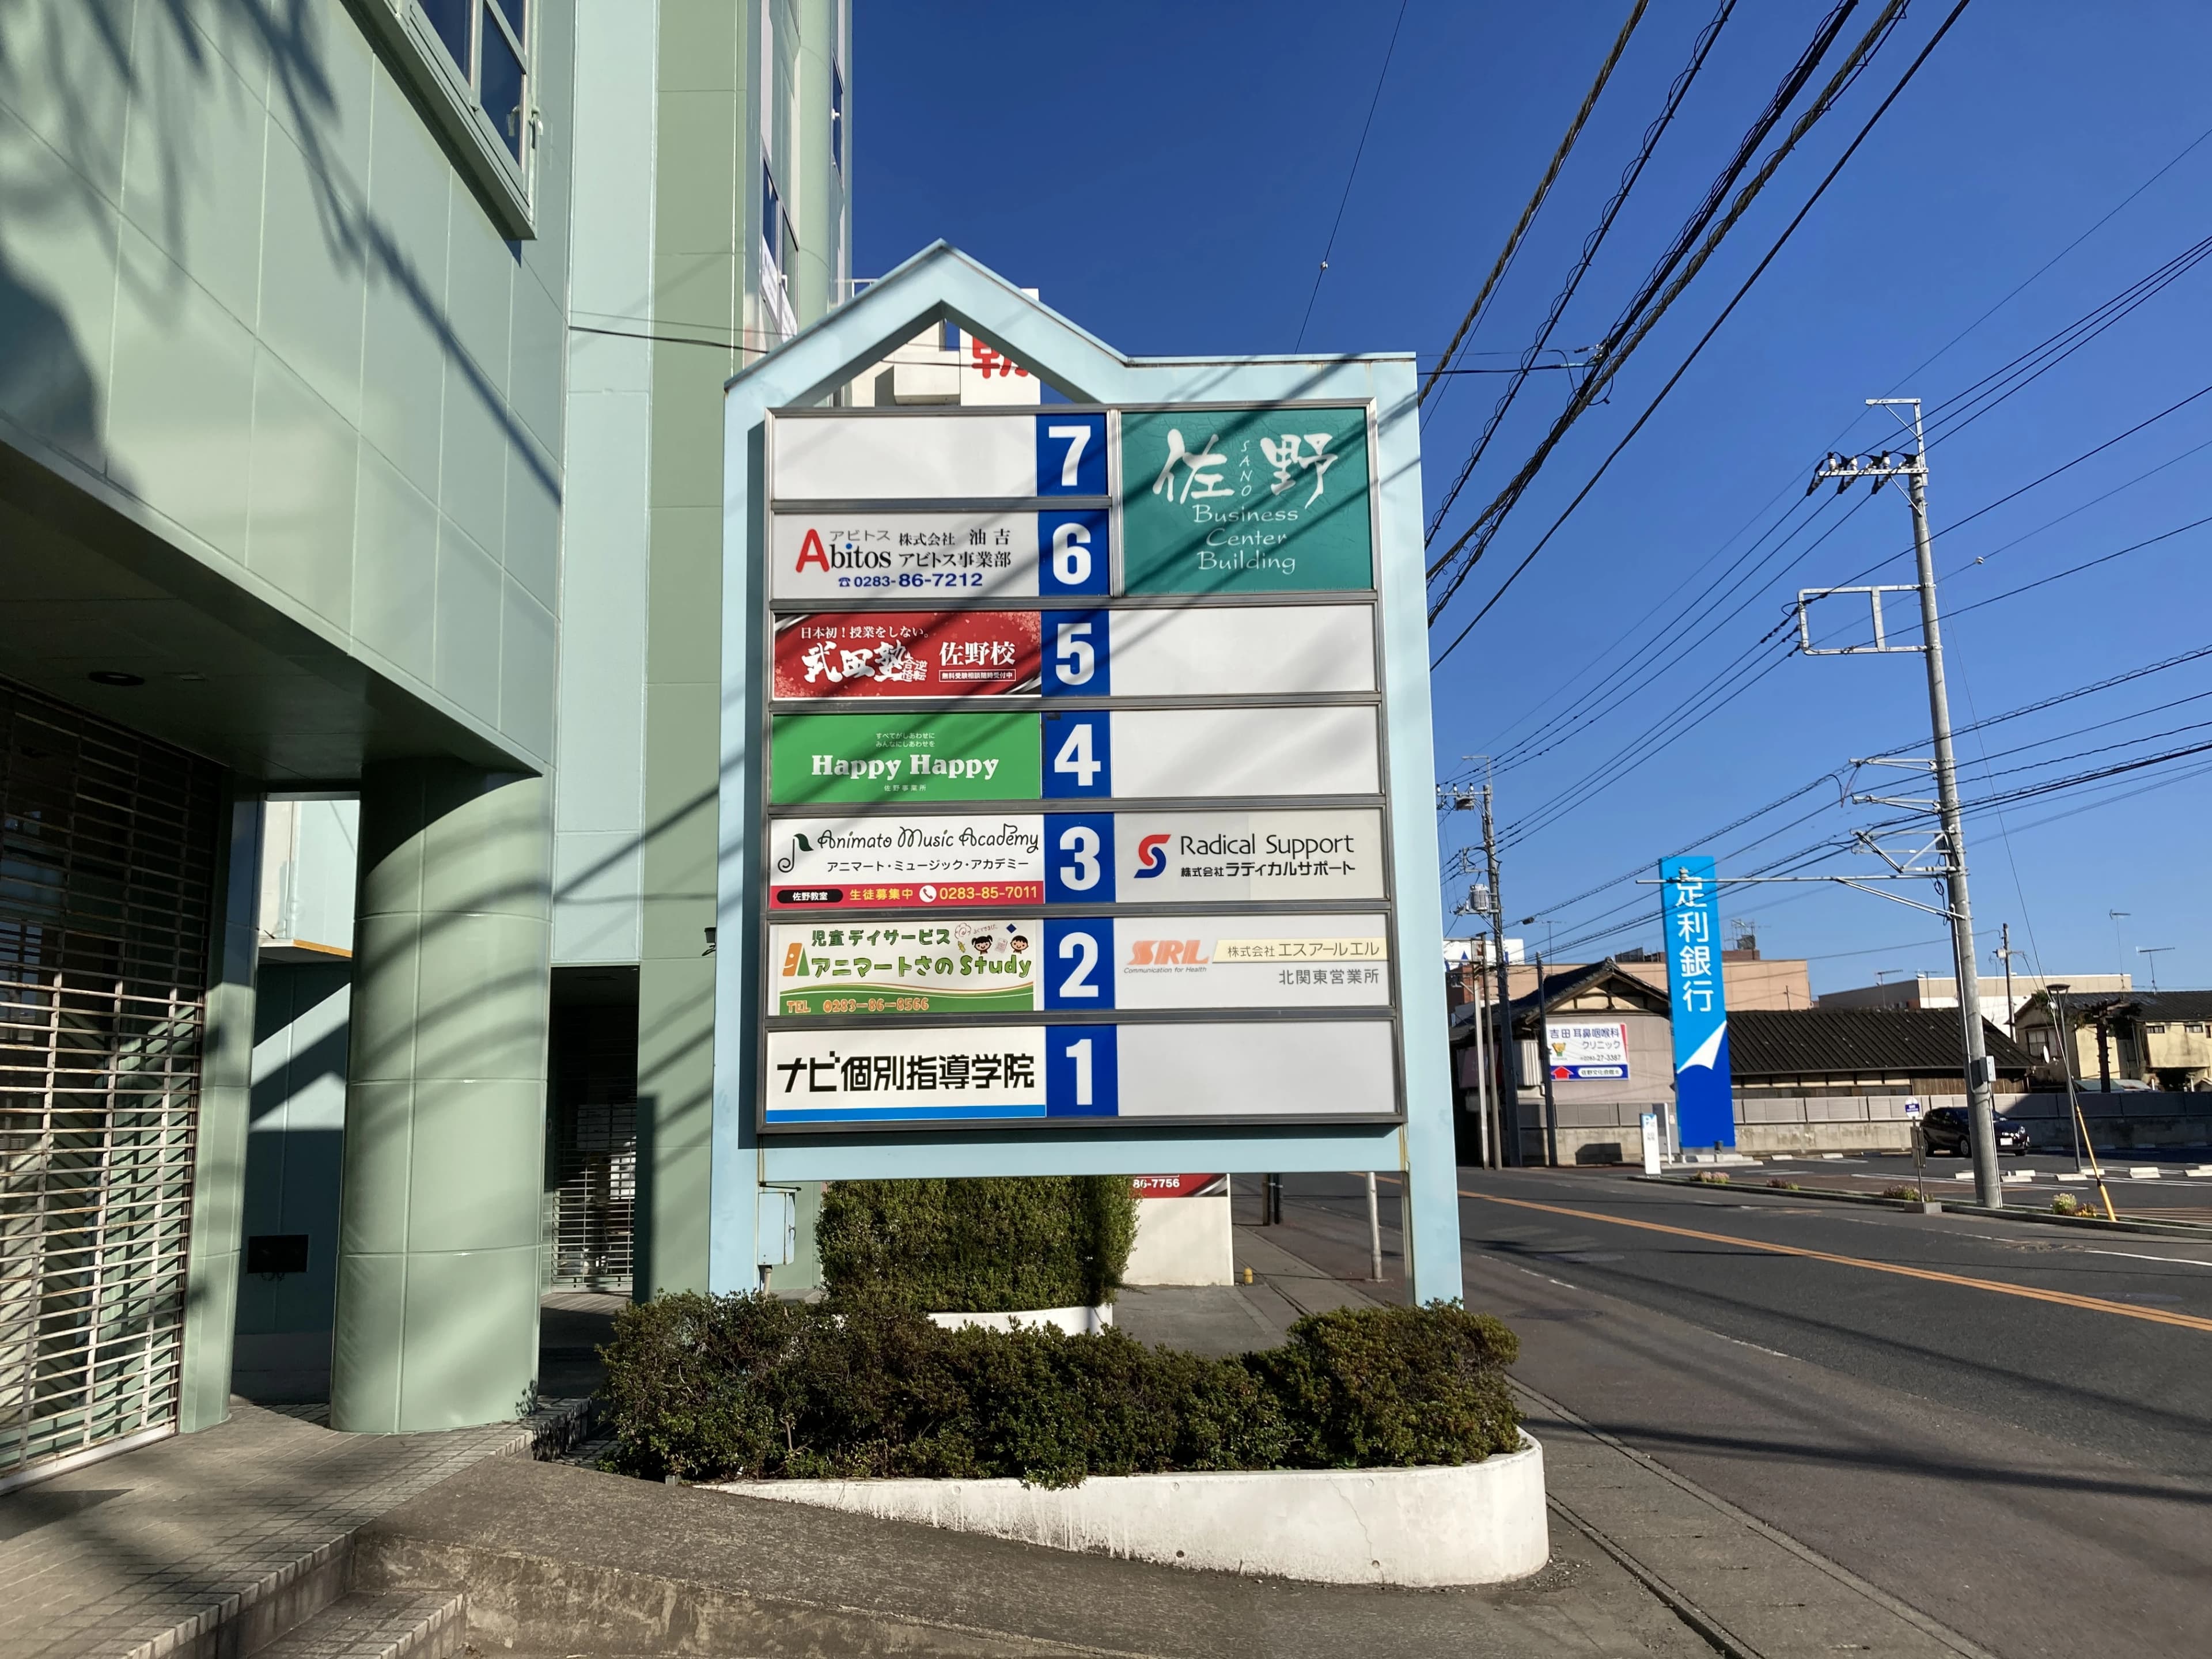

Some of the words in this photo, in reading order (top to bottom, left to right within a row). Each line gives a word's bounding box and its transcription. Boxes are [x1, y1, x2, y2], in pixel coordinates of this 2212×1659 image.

[1048, 426, 1091, 486] 7
[1239, 440, 1252, 497] SANO
[1152, 429, 1338, 510] 佐野
[1192, 504, 1298, 523] Business
[830, 529, 891, 541] アビトス
[899, 533, 955, 547] 株式会社
[1206, 528, 1287, 547] Center
[796, 528, 891, 573] Abitos
[899, 551, 1011, 568] アビトス事業部
[1052, 522, 1092, 585] 6
[1196, 550, 1296, 574] Building
[854, 573, 983, 587] 0283-86-7212
[939, 641, 1016, 666] 佐野校
[1055, 623, 1094, 686] 5
[812, 755, 902, 781] Happy
[910, 754, 999, 780] Happy
[1054, 724, 1101, 786] 4
[817, 829, 892, 849] Animato
[897, 825, 954, 849] Music
[959, 823, 1039, 854] Academy
[1180, 833, 1256, 856] Radical
[1266, 834, 1355, 859] Support
[1059, 825, 1101, 891] 3
[793, 892, 828, 902] 佐野教室
[850, 888, 914, 902] 生徒募集中
[940, 886, 1037, 900] 0283-85-7011
[1127, 940, 1210, 965] SRL
[1675, 877, 1714, 1012] 足利銀行
[960, 955, 1032, 978] Study
[1059, 931, 1099, 998] 2
[1279, 968, 1380, 985] 北関東営業所
[786, 999, 811, 1013] TEL
[1582, 1041, 1620, 1050] クリニック
[777, 1051, 1035, 1093] ナビ個別指導学院
[1066, 1039, 1093, 1105] 1
